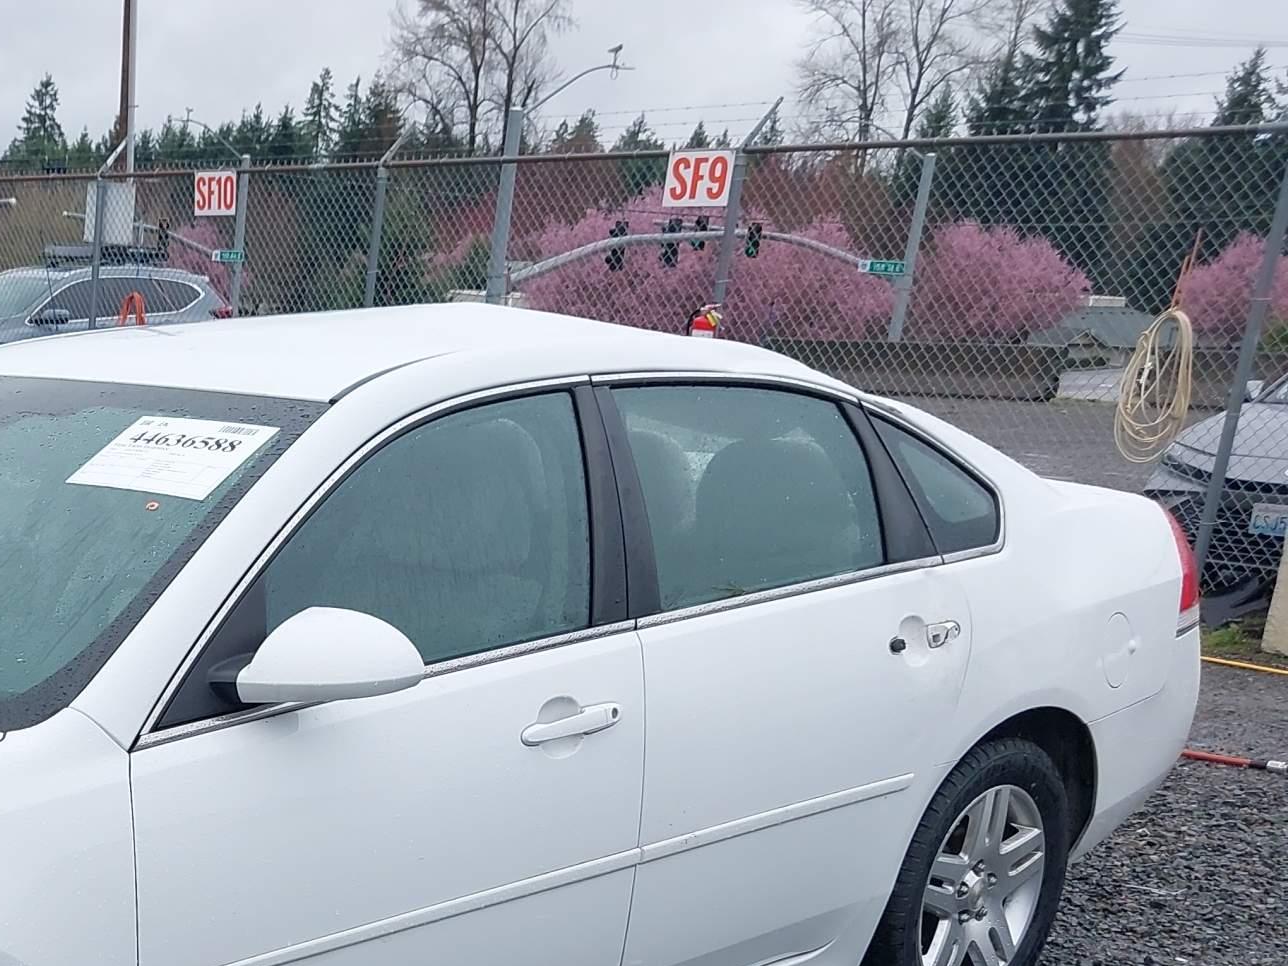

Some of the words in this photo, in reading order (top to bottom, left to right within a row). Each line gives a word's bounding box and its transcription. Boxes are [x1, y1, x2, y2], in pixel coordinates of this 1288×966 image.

[195, 175, 236, 211] SF10
[668, 156, 729, 201] SF9
[129, 431, 243, 453] 44636588
